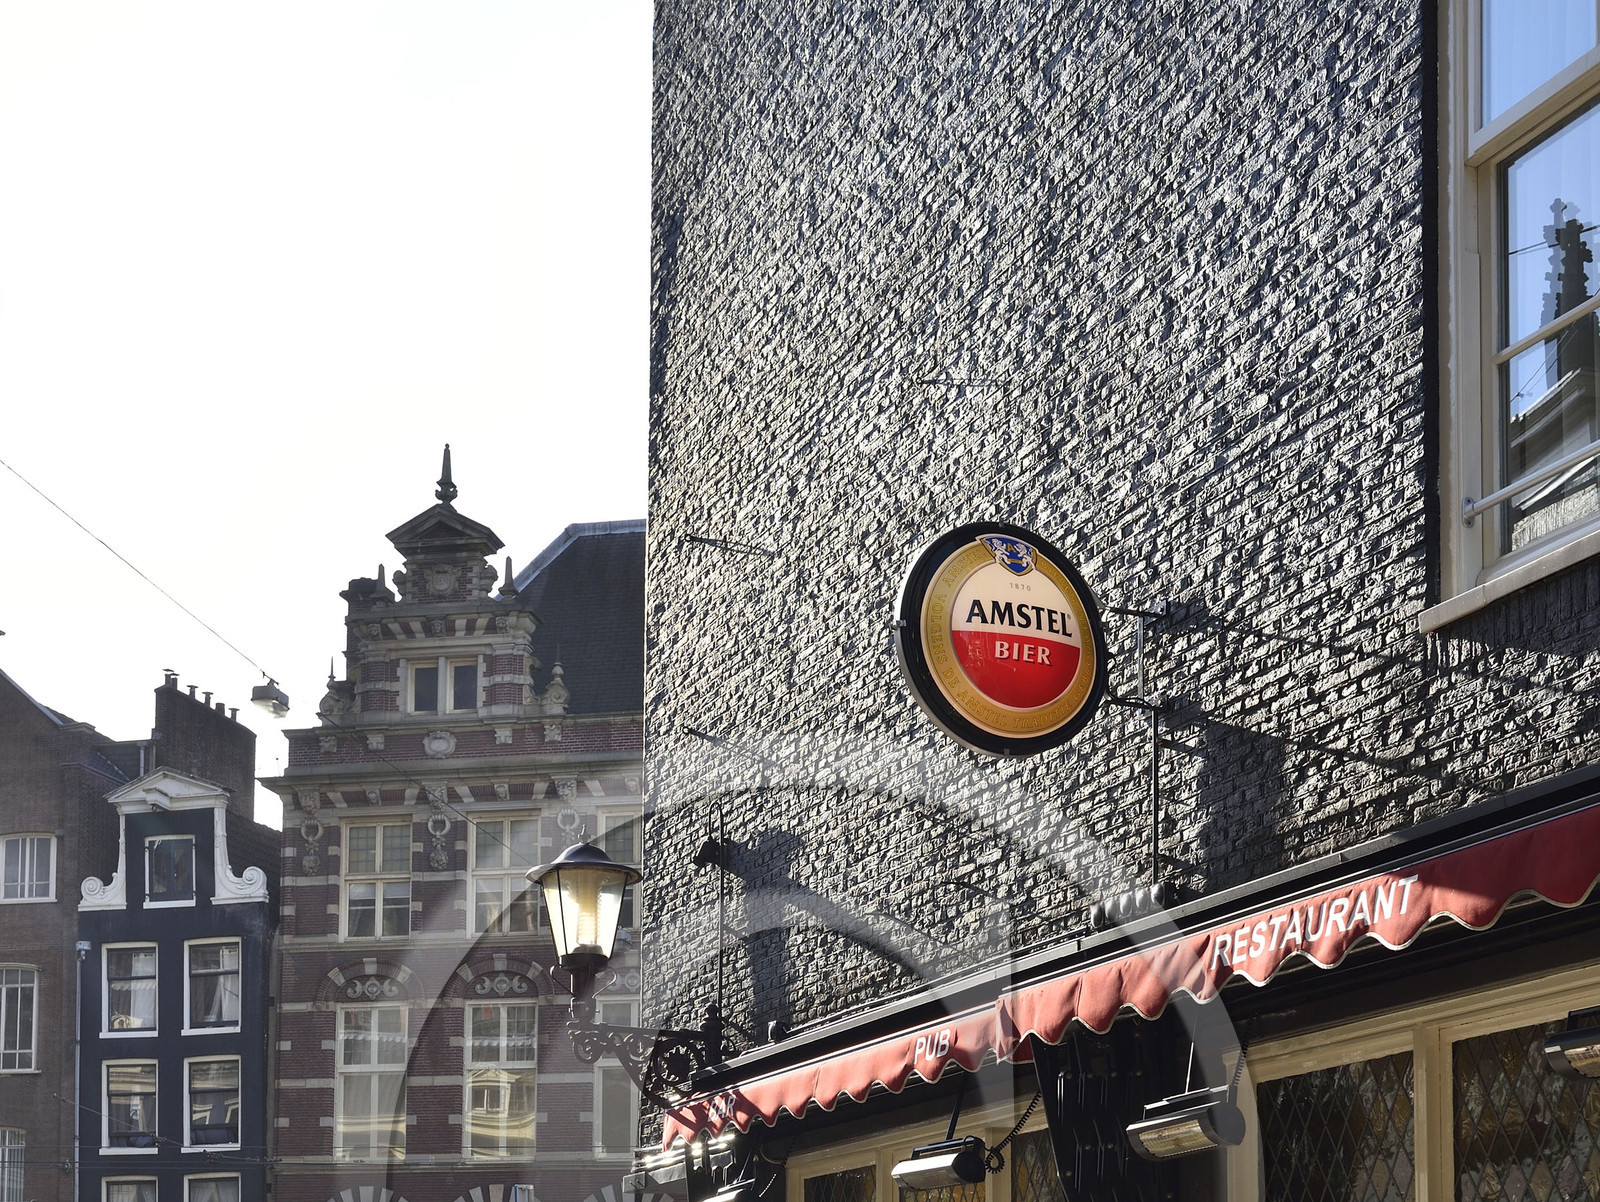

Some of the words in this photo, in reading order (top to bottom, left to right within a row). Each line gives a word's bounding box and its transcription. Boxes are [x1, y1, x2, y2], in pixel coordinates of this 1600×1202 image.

[1009, 582, 1031, 592] 1870
[966, 599, 1072, 637] AMSTEL
[995, 641, 1051, 665] BIER
[943, 667, 960, 689] DE
[957, 689, 1007, 727] AMSTEL
[1211, 874, 1419, 970] RESTAURANT
[914, 1028, 951, 1065] PUB
[707, 1095, 736, 1122] BAR
